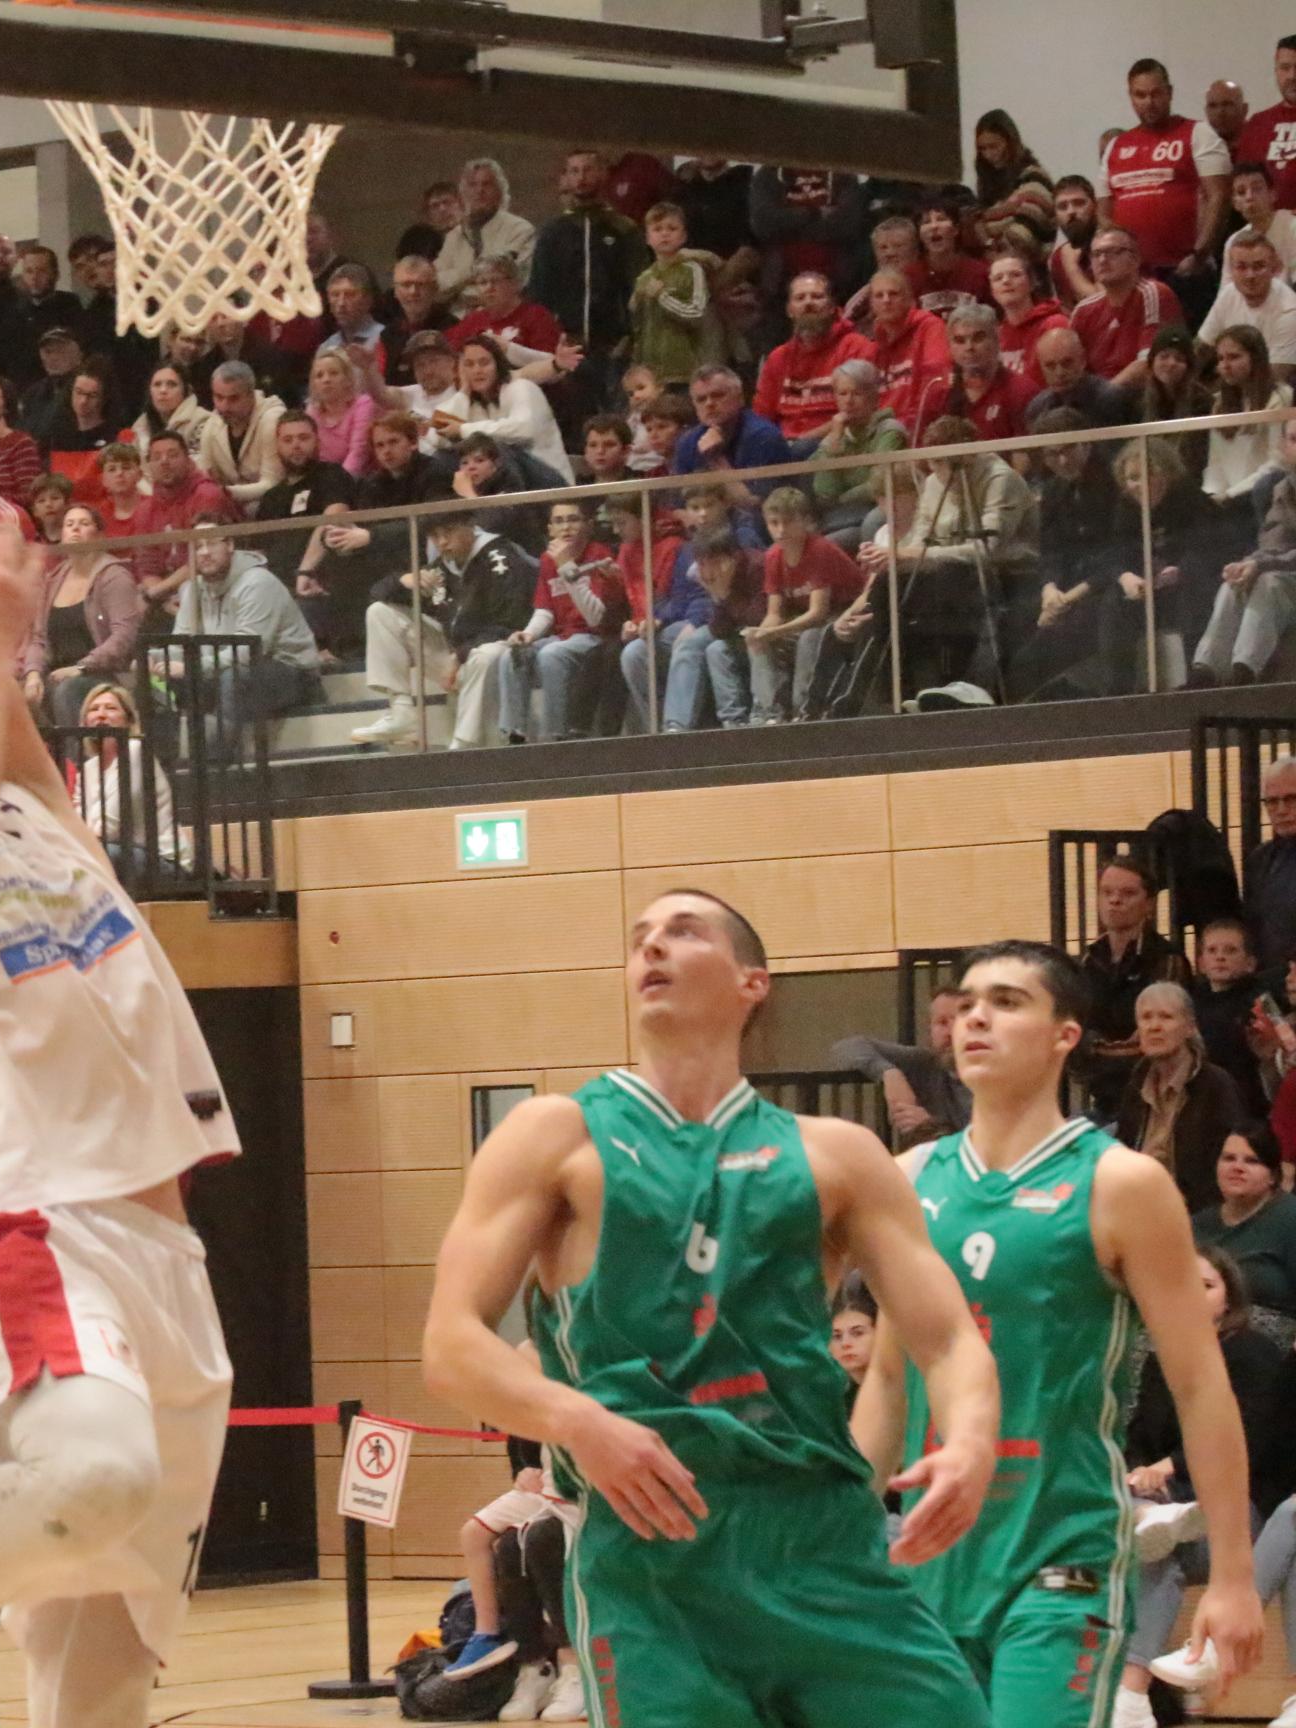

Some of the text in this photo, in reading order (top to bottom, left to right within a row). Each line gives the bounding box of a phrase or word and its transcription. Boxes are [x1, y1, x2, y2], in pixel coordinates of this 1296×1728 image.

[1152, 140, 1184, 162] 60
[685, 1221, 720, 1275] 6
[961, 1231, 996, 1281] 9
